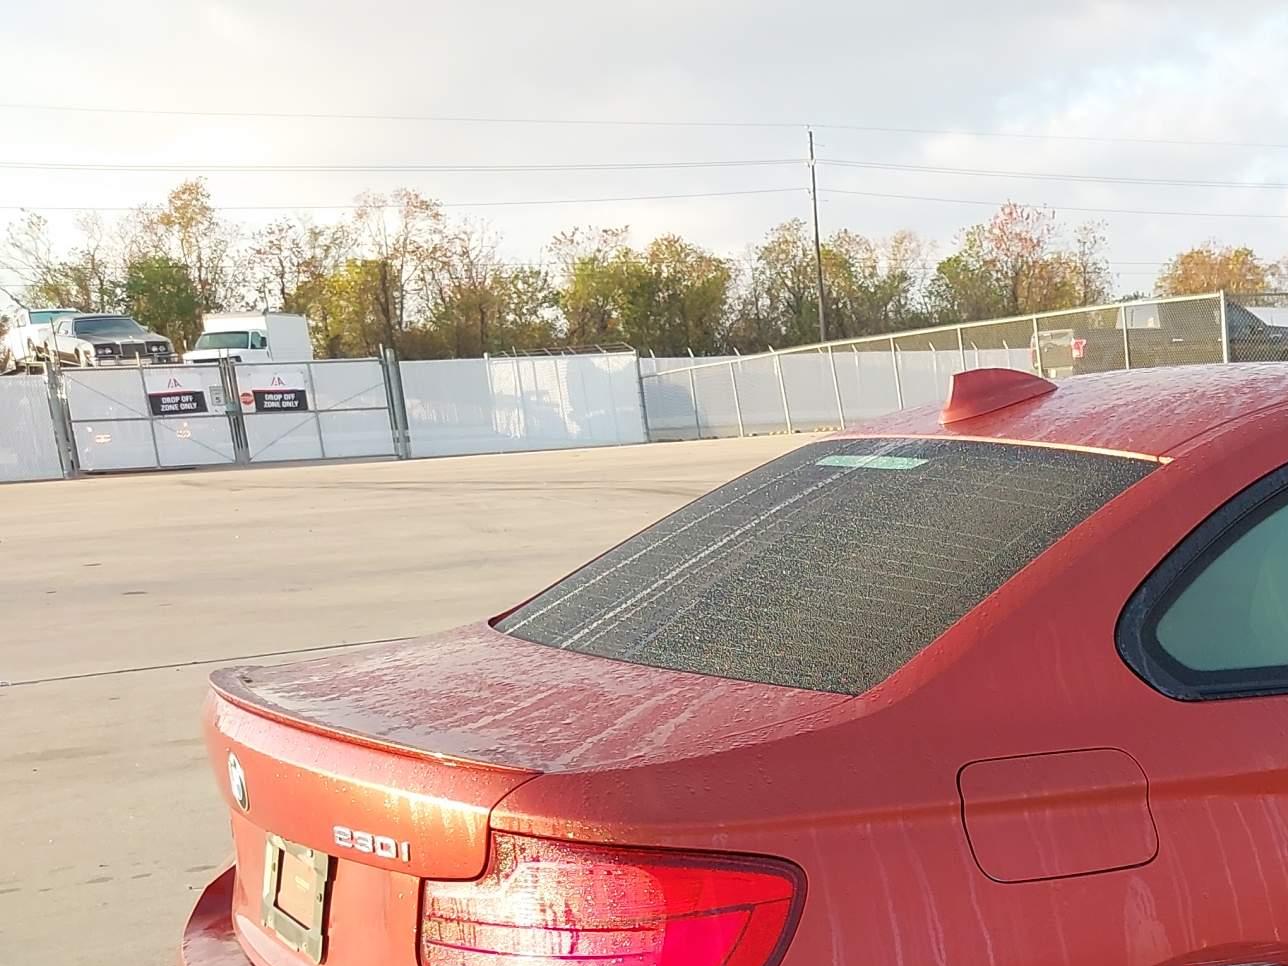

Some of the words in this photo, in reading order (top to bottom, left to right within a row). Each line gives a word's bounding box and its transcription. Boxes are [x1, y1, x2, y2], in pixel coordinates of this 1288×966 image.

[161, 396, 180, 404] DROP
[264, 393, 283, 401] DROP
[161, 404, 180, 412] ZONE
[180, 402, 197, 410] ONLY
[282, 400, 299, 408] ONLY
